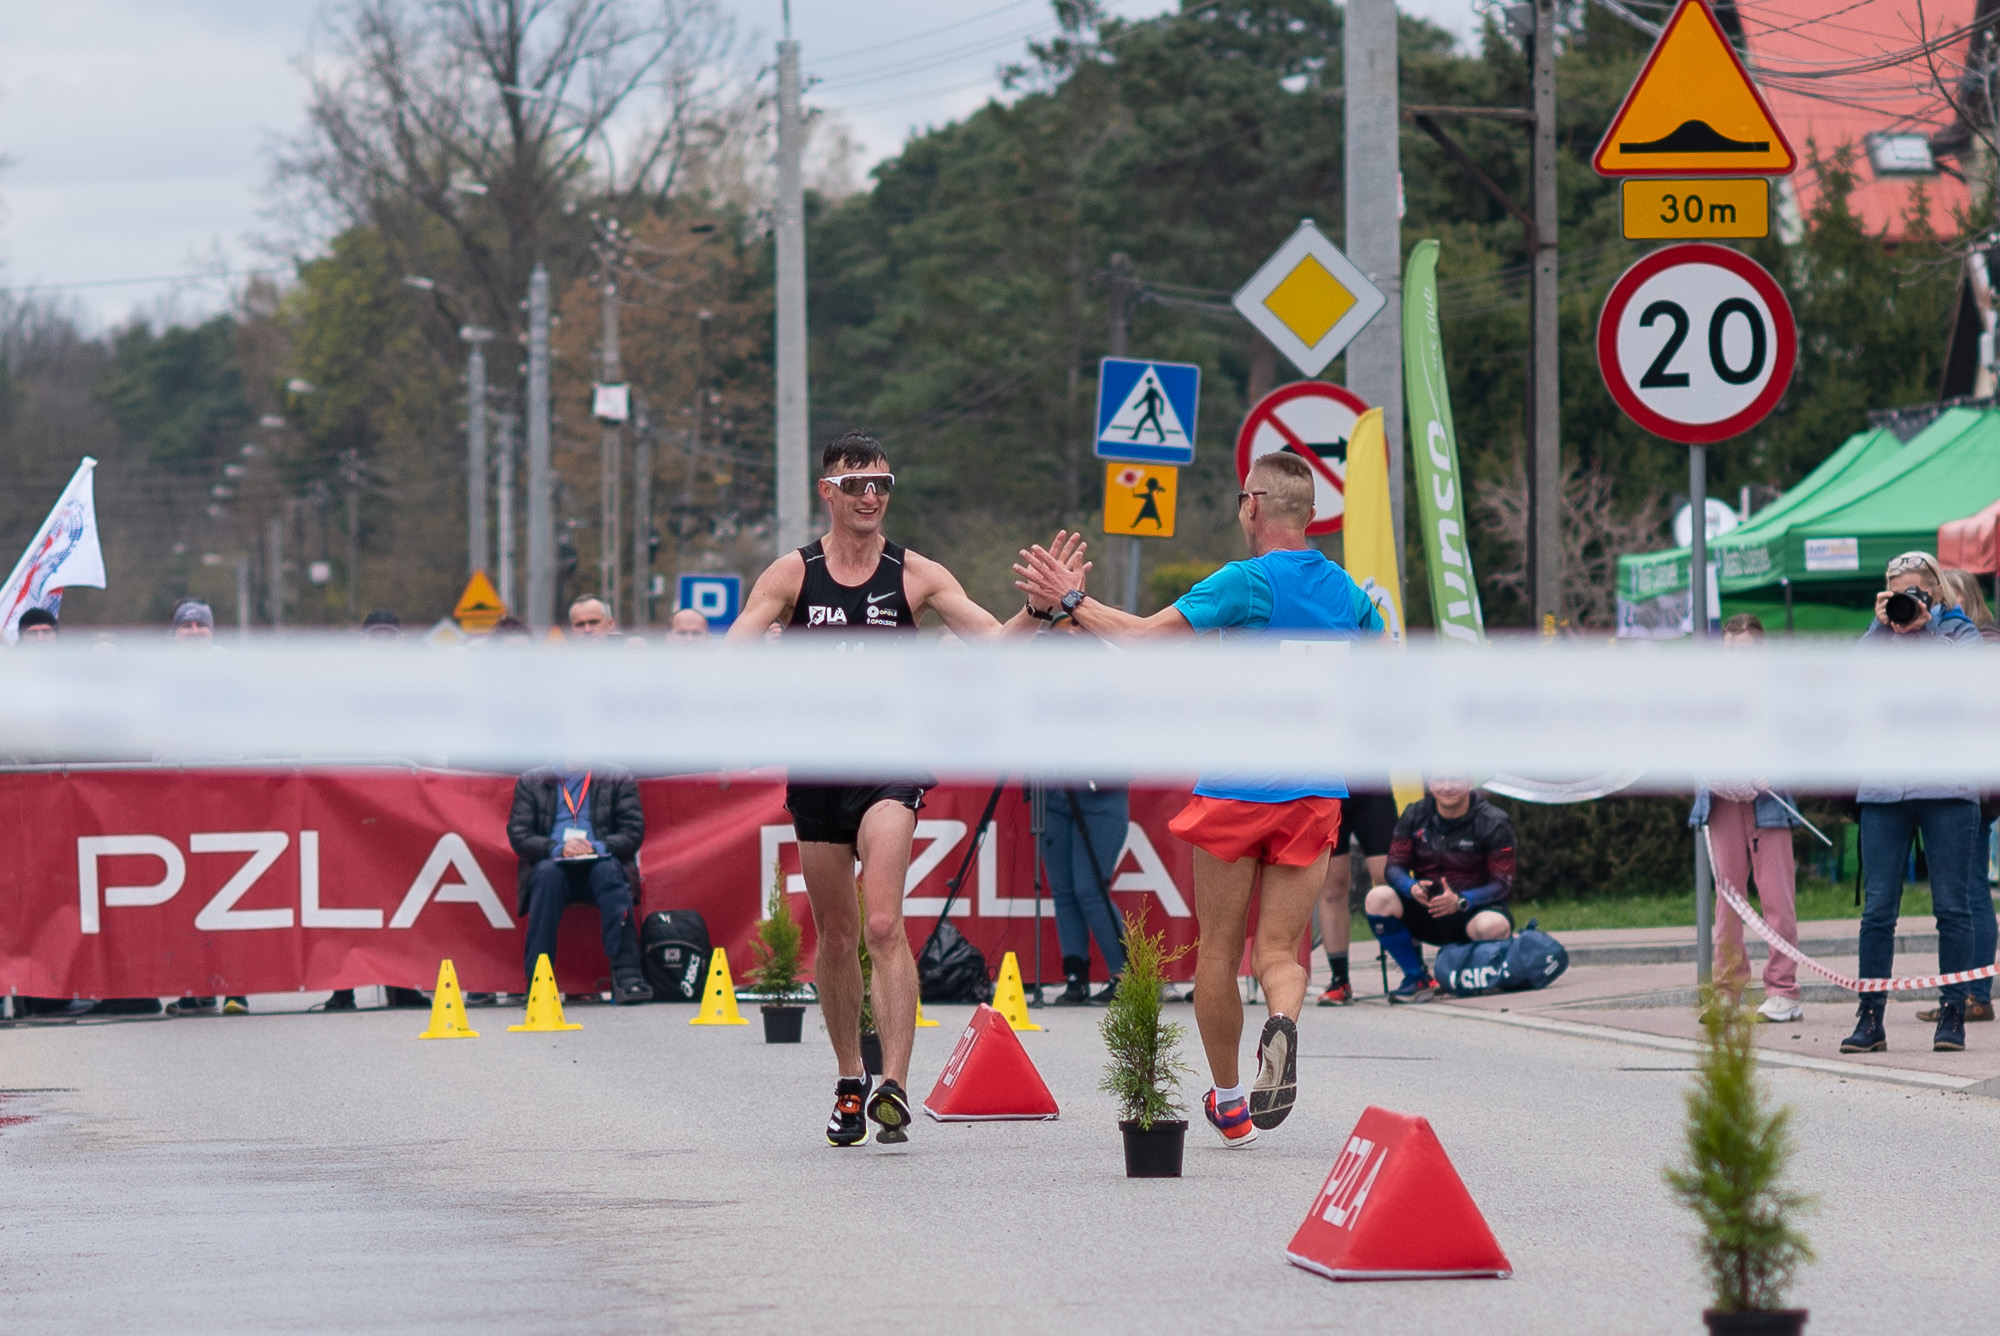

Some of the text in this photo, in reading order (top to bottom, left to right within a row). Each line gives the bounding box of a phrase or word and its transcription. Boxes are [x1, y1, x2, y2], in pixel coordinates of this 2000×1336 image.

[1660, 194, 1736, 224] 30m
[1638, 297, 1768, 389] 20
[77, 829, 516, 934] PZLA
[760, 818, 1192, 921] PZLA
[1311, 1135, 1389, 1232] PZLA
